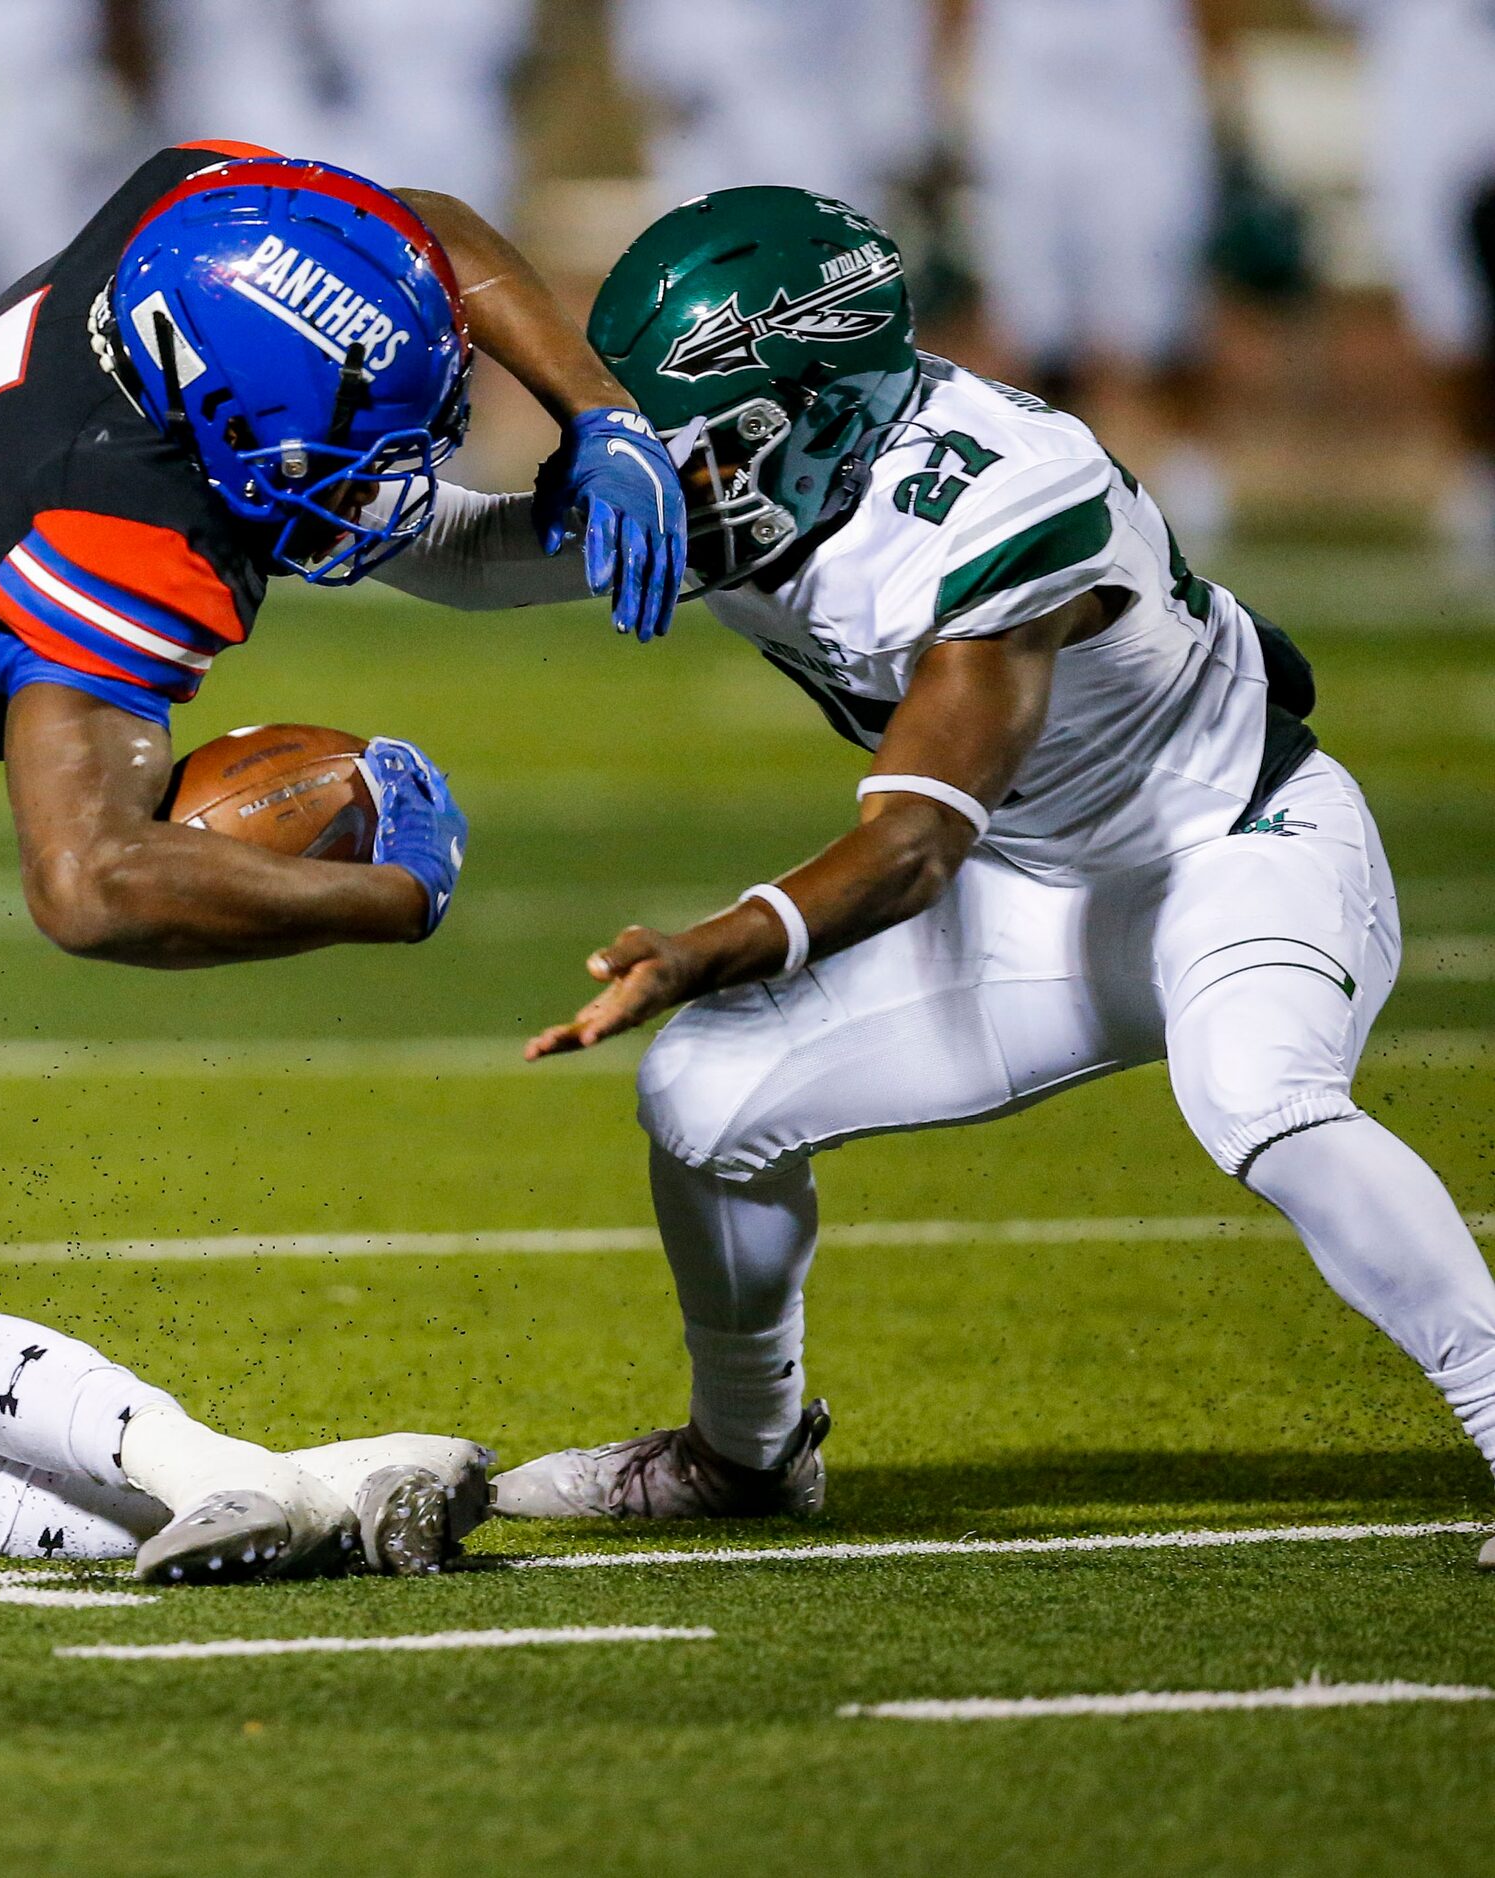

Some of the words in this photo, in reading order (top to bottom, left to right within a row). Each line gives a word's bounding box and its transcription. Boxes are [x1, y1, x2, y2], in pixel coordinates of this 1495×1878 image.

[230, 235, 410, 371] PANTHERS
[819, 239, 885, 284] INDIANS
[892, 430, 1005, 526] 27
